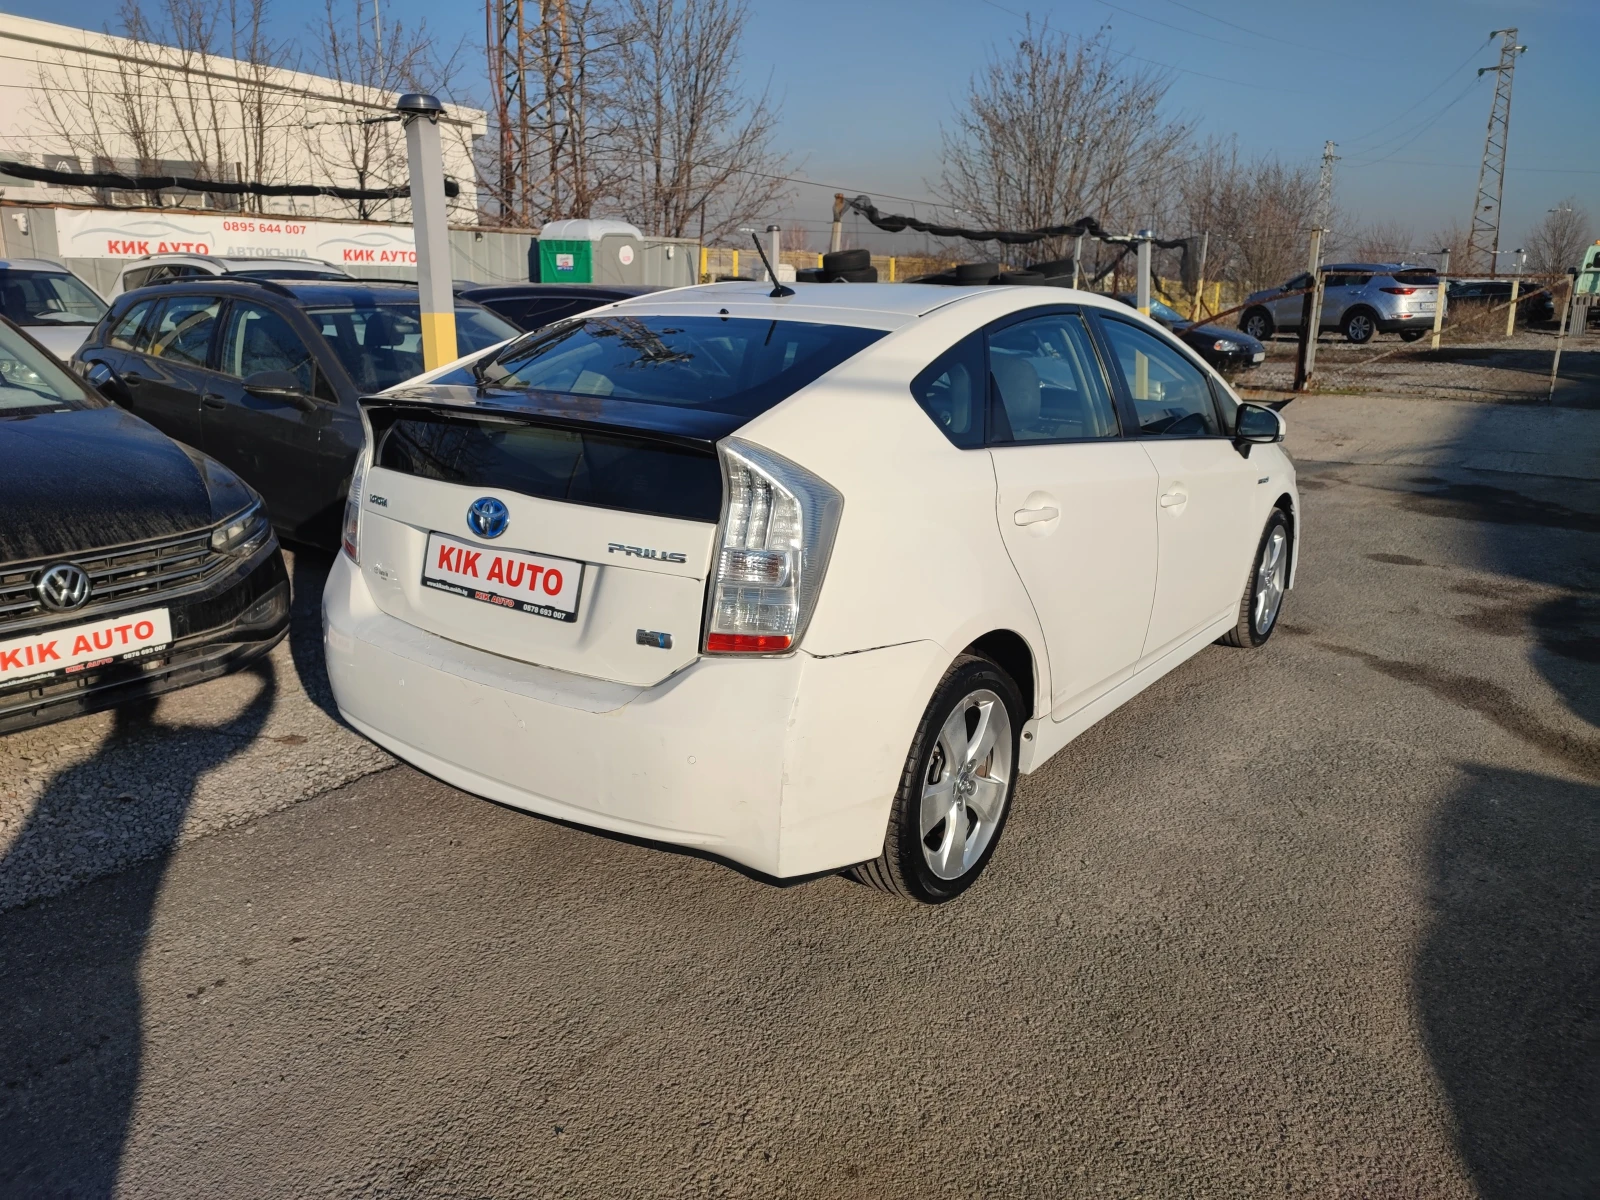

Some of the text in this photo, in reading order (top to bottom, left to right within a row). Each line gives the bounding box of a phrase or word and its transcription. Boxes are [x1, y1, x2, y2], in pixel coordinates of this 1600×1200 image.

[223, 221, 306, 234] 0895 644 007
[107, 240, 209, 255] КИК АУТО
[343, 249, 375, 262] КИК
[608, 543, 687, 564] PRIUS
[438, 545, 563, 596] KIK AUTO
[475, 591, 515, 608] KIK AUTO
[523, 603, 566, 620] 0878 693 007
[0, 621, 154, 671] KIK AUTO
[154, 644, 167, 652] 007
[65, 657, 113, 674] KIK AUTO
